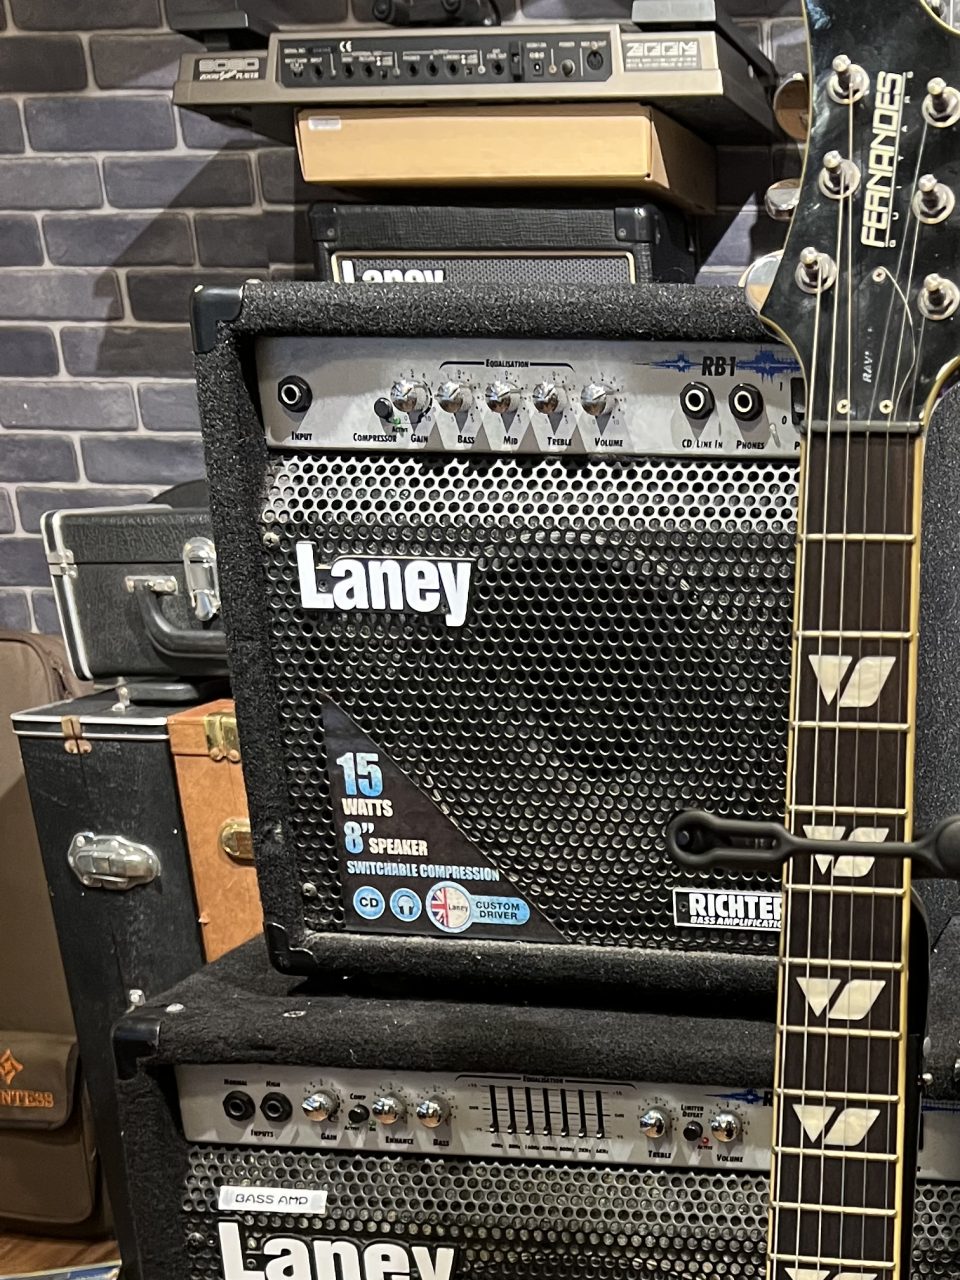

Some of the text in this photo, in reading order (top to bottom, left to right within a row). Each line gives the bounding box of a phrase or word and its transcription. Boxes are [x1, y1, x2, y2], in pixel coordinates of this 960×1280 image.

[626, 41, 697, 57] ZOOM
[861, 70, 903, 248] FERNANDES
[702, 356, 736, 377] RB1
[296, 541, 472, 627] Laney
[336, 752, 383, 796] 15
[342, 798, 393, 818] WATTS
[368, 838, 429, 857] SPEAKER
[346, 860, 500, 882] SWITCHABLE COMPRESSION
[359, 896, 379, 908] CD
[475, 901, 520, 912] CUSTOM
[479, 909, 518, 921] DRIVER
[690, 916, 716, 925] BASS
[234, 1192, 275, 1205] BASS
